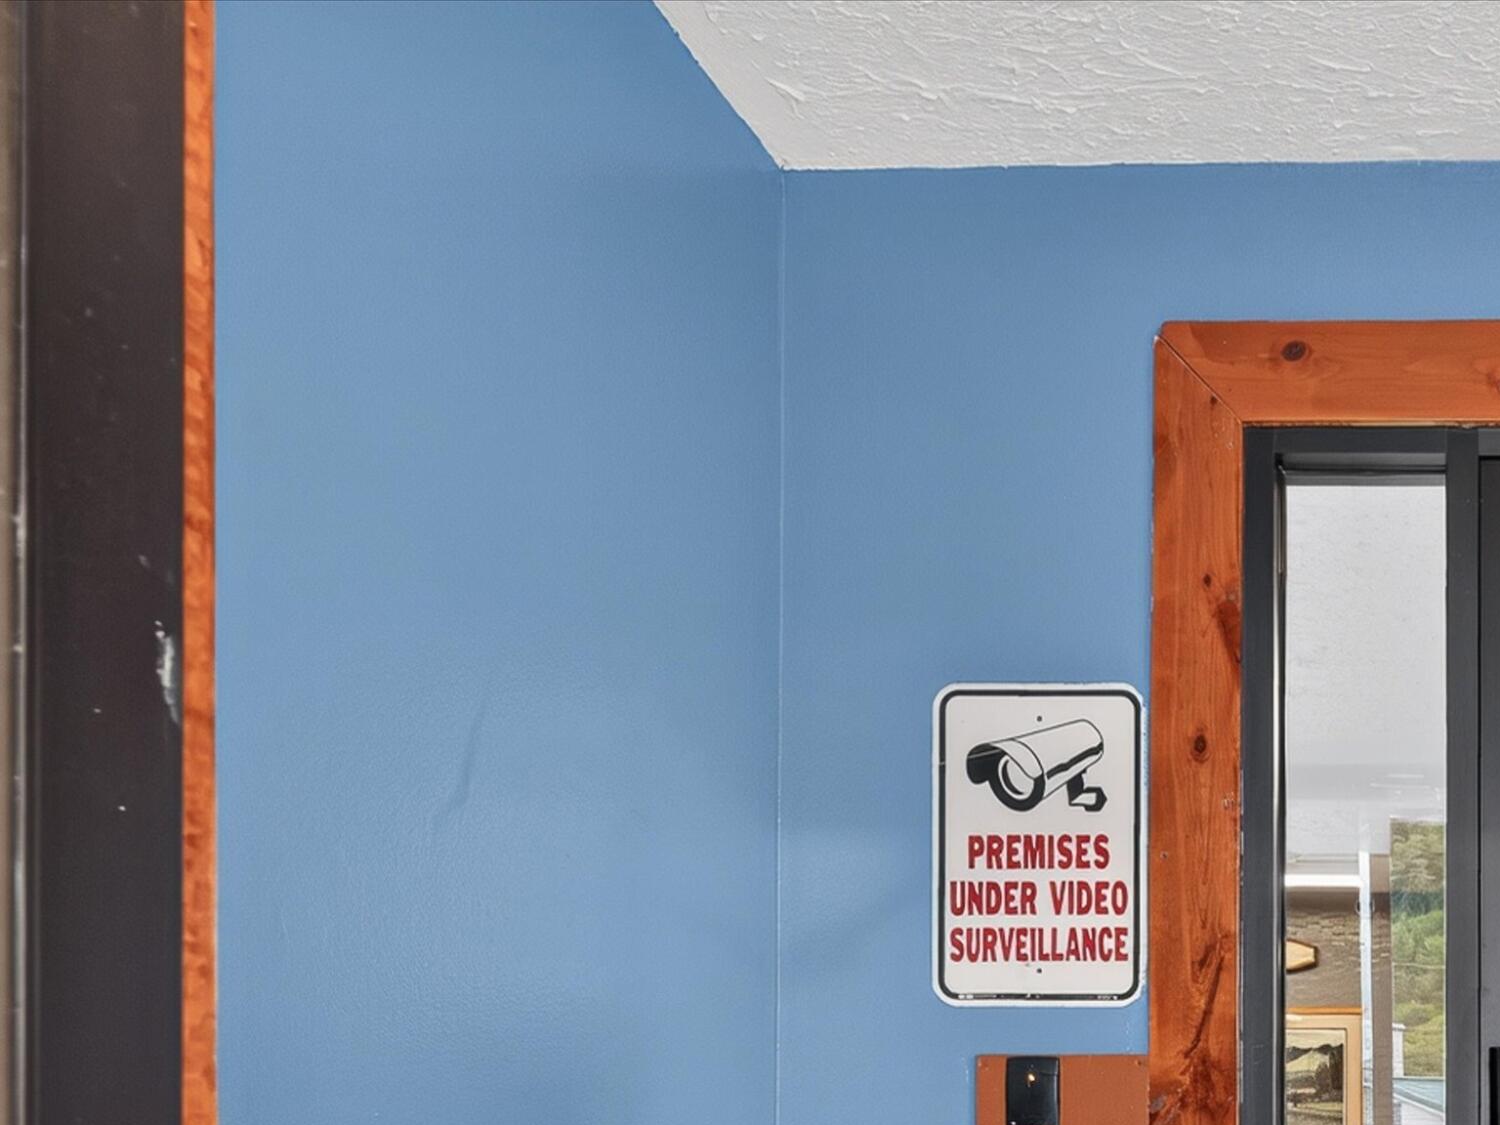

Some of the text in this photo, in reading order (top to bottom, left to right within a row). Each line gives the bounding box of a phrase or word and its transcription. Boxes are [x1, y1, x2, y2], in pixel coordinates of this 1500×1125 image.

[967, 833, 1111, 870] PREMISES
[949, 880, 1129, 917] UNDER VIDEO
[949, 926, 1129, 963] SURVEILLANCE
